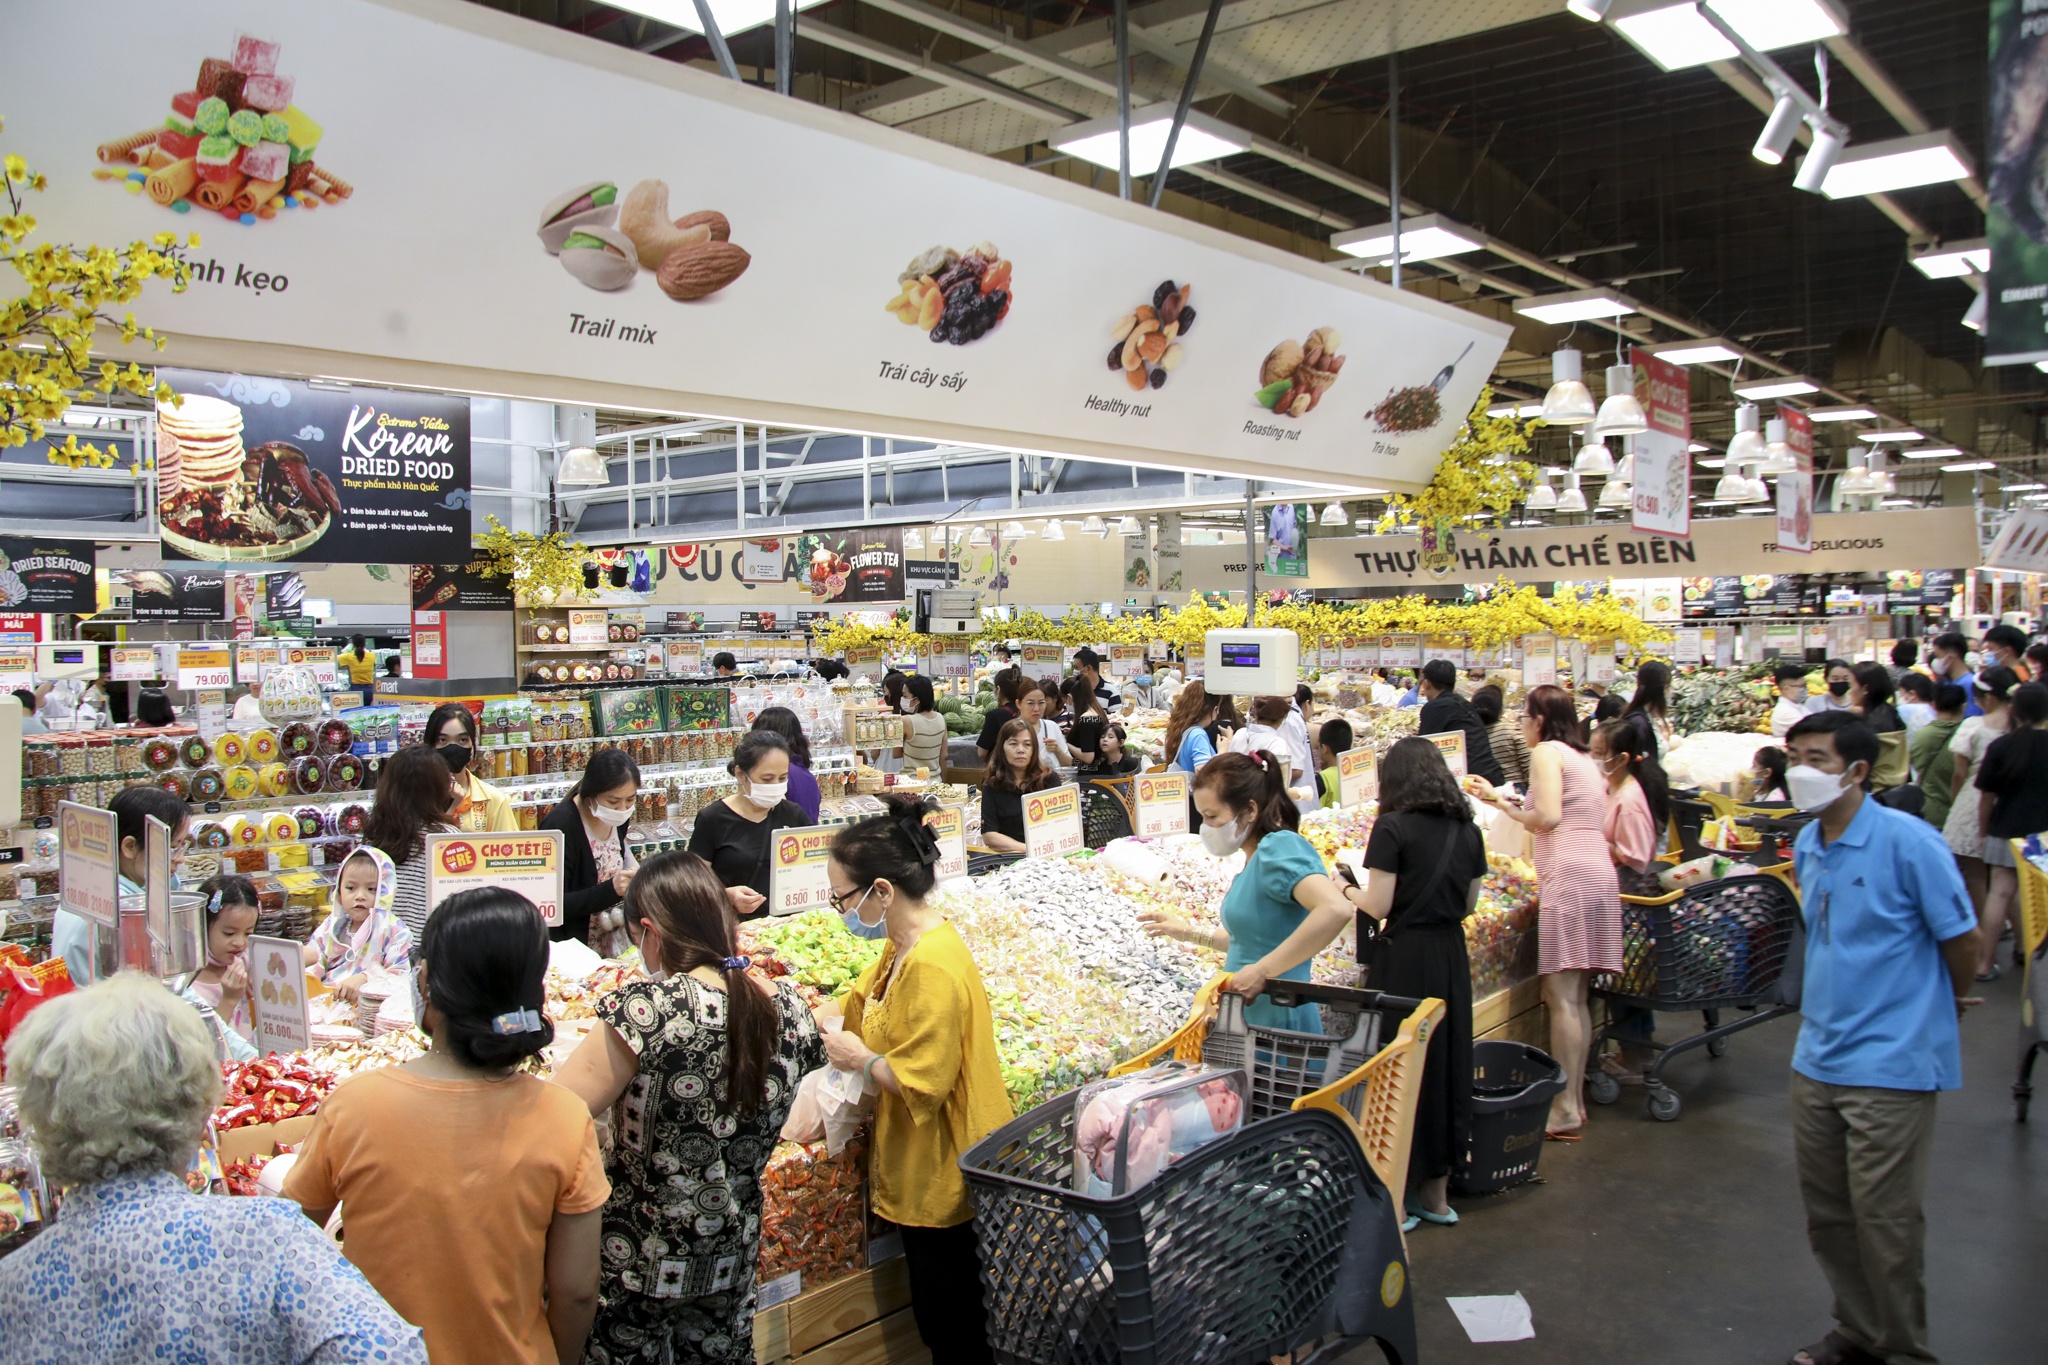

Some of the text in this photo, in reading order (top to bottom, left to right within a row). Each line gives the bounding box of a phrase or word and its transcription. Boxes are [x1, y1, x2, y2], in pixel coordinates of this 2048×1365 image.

[234, 263, 289, 296] kẹo
[570, 313, 657, 345] Trail mix
[878, 361, 967, 392] Trái cây sấy
[1084, 394, 1152, 418] Healthy nut
[376, 412, 450, 430] Extreme Value
[341, 404, 454, 458] Korean
[1243, 420, 1302, 441] Roasting nut
[1372, 441, 1400, 456] Trà hoa
[341, 456, 455, 480] DRIED FOOD
[341, 478, 440, 492] Thực phẩm khô Hàn Quốc
[350, 522, 366, 530] Bánh
[1811, 538, 1884, 551] DELICIOUS
[850, 551, 899, 570] FLOWER TEA
[1160, 550, 1180, 558] ORGANIC
[1355, 549, 1420, 578] THỰ
[1456, 537, 1538, 570] HẨM
[1544, 534, 1611, 568] CHẾ
[11, 556, 92, 575] DRIED SEAFOOD
[920, 566, 931, 574] VỰC
[931, 566, 941, 574] CÂN
[1223, 563, 1265, 573] PREPRE
[181, 575, 225, 592] Premium
[4, 621, 24, 629] MÃI
[681, 664, 699, 672] 42.900
[945, 666, 968, 675] 19.800
[1127, 667, 1141, 675] 7.290
[195, 674, 229, 685] 79.000
[375, 679, 398, 694] emart
[1154, 779, 1178, 790] CHỢ TẾT
[1359, 785, 1375, 800] 6.400
[1044, 793, 1069, 808] CHỢ TẾT
[942, 813, 953, 825] TẾT
[1146, 819, 1185, 833] 5.900 5.900
[480, 840, 541, 858] CHỢ TẾT
[802, 836, 819, 849] CHỢ
[1033, 835, 1080, 857] 11.500 10.500
[446, 848, 456, 856] ĐẢM
[455, 849, 474, 867] RẺ
[941, 860, 962, 874] 12.500
[785, 888, 832, 907] 8.500 10.8
[264, 1021, 292, 1039] 26.000
